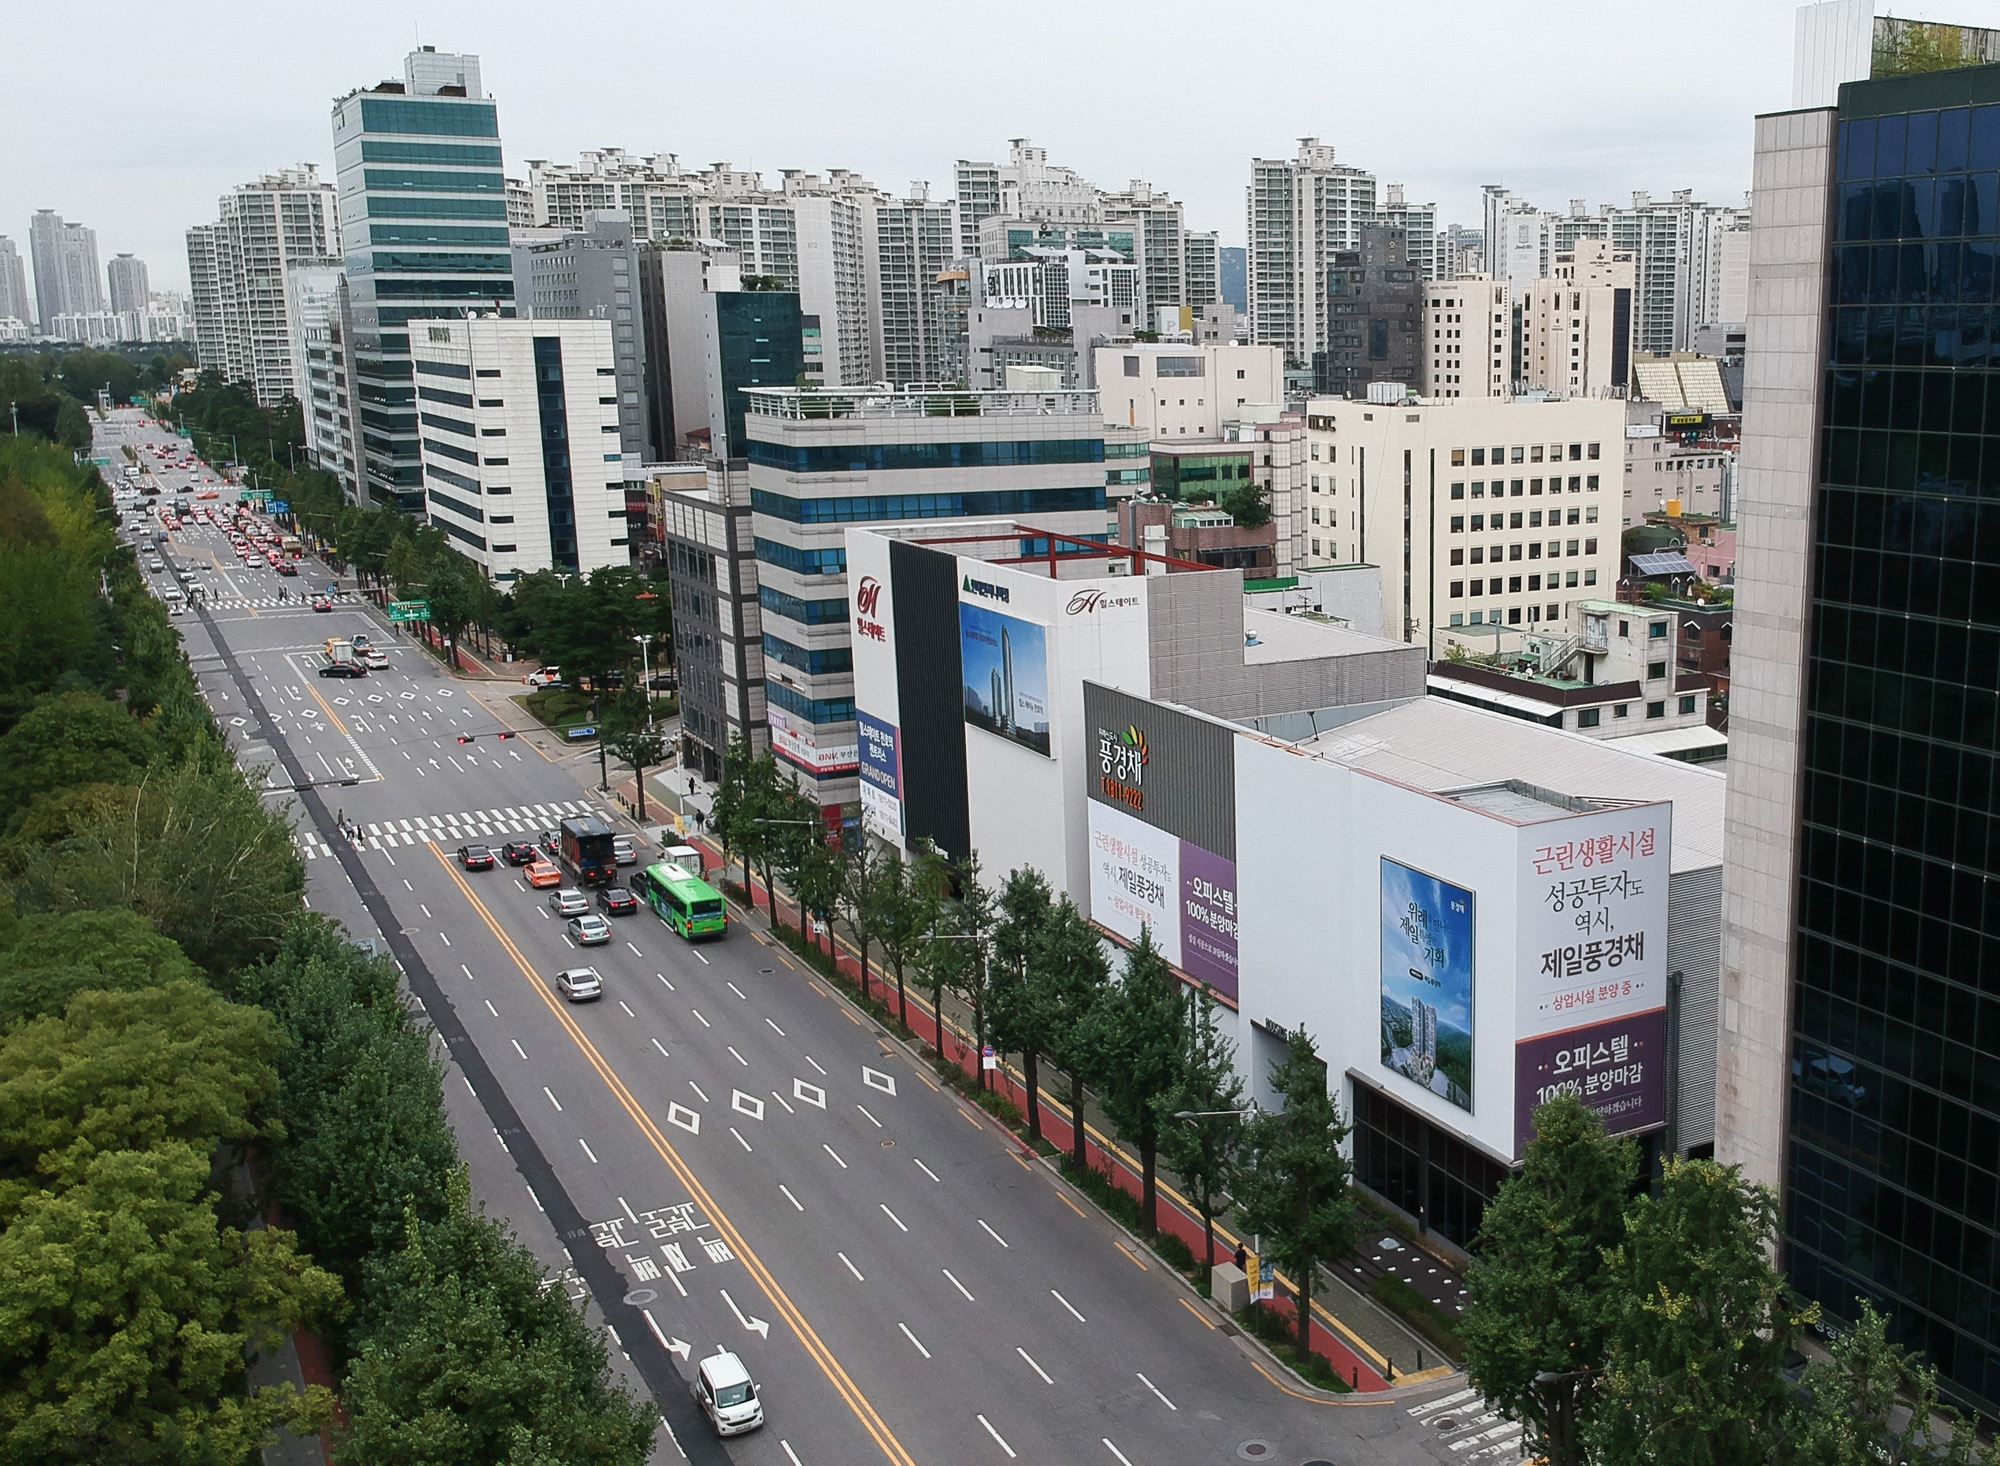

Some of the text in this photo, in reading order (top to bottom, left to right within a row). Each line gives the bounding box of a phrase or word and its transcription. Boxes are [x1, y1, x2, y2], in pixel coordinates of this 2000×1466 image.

[1100, 597, 1140, 608] 힐스테이트
[818, 752, 838, 762] BNK
[861, 761, 880, 782] GRAND
[880, 769, 896, 790] OPEN
[1098, 739, 1142, 786] 풍경채
[1094, 831, 1172, 882] 근린생활시설 성공투자도
[1532, 828, 1655, 875] 근린생활시설
[1102, 862, 1165, 909] 역시, 제일풍경채
[1192, 876, 1234, 916] 오피스텔
[1544, 870, 1644, 912] 성공투자도
[1186, 900, 1210, 924] 100%
[1400, 916, 1419, 944] 제일
[1574, 906, 1614, 936] 역시,
[1424, 946, 1445, 969] 기회
[1540, 930, 1644, 978] 제일풍경채
[1552, 980, 1632, 1011] 상업시설 분양 중
[1552, 1034, 1629, 1075] 오피스텔
[1536, 1062, 1644, 1106] 100% 분양마감
